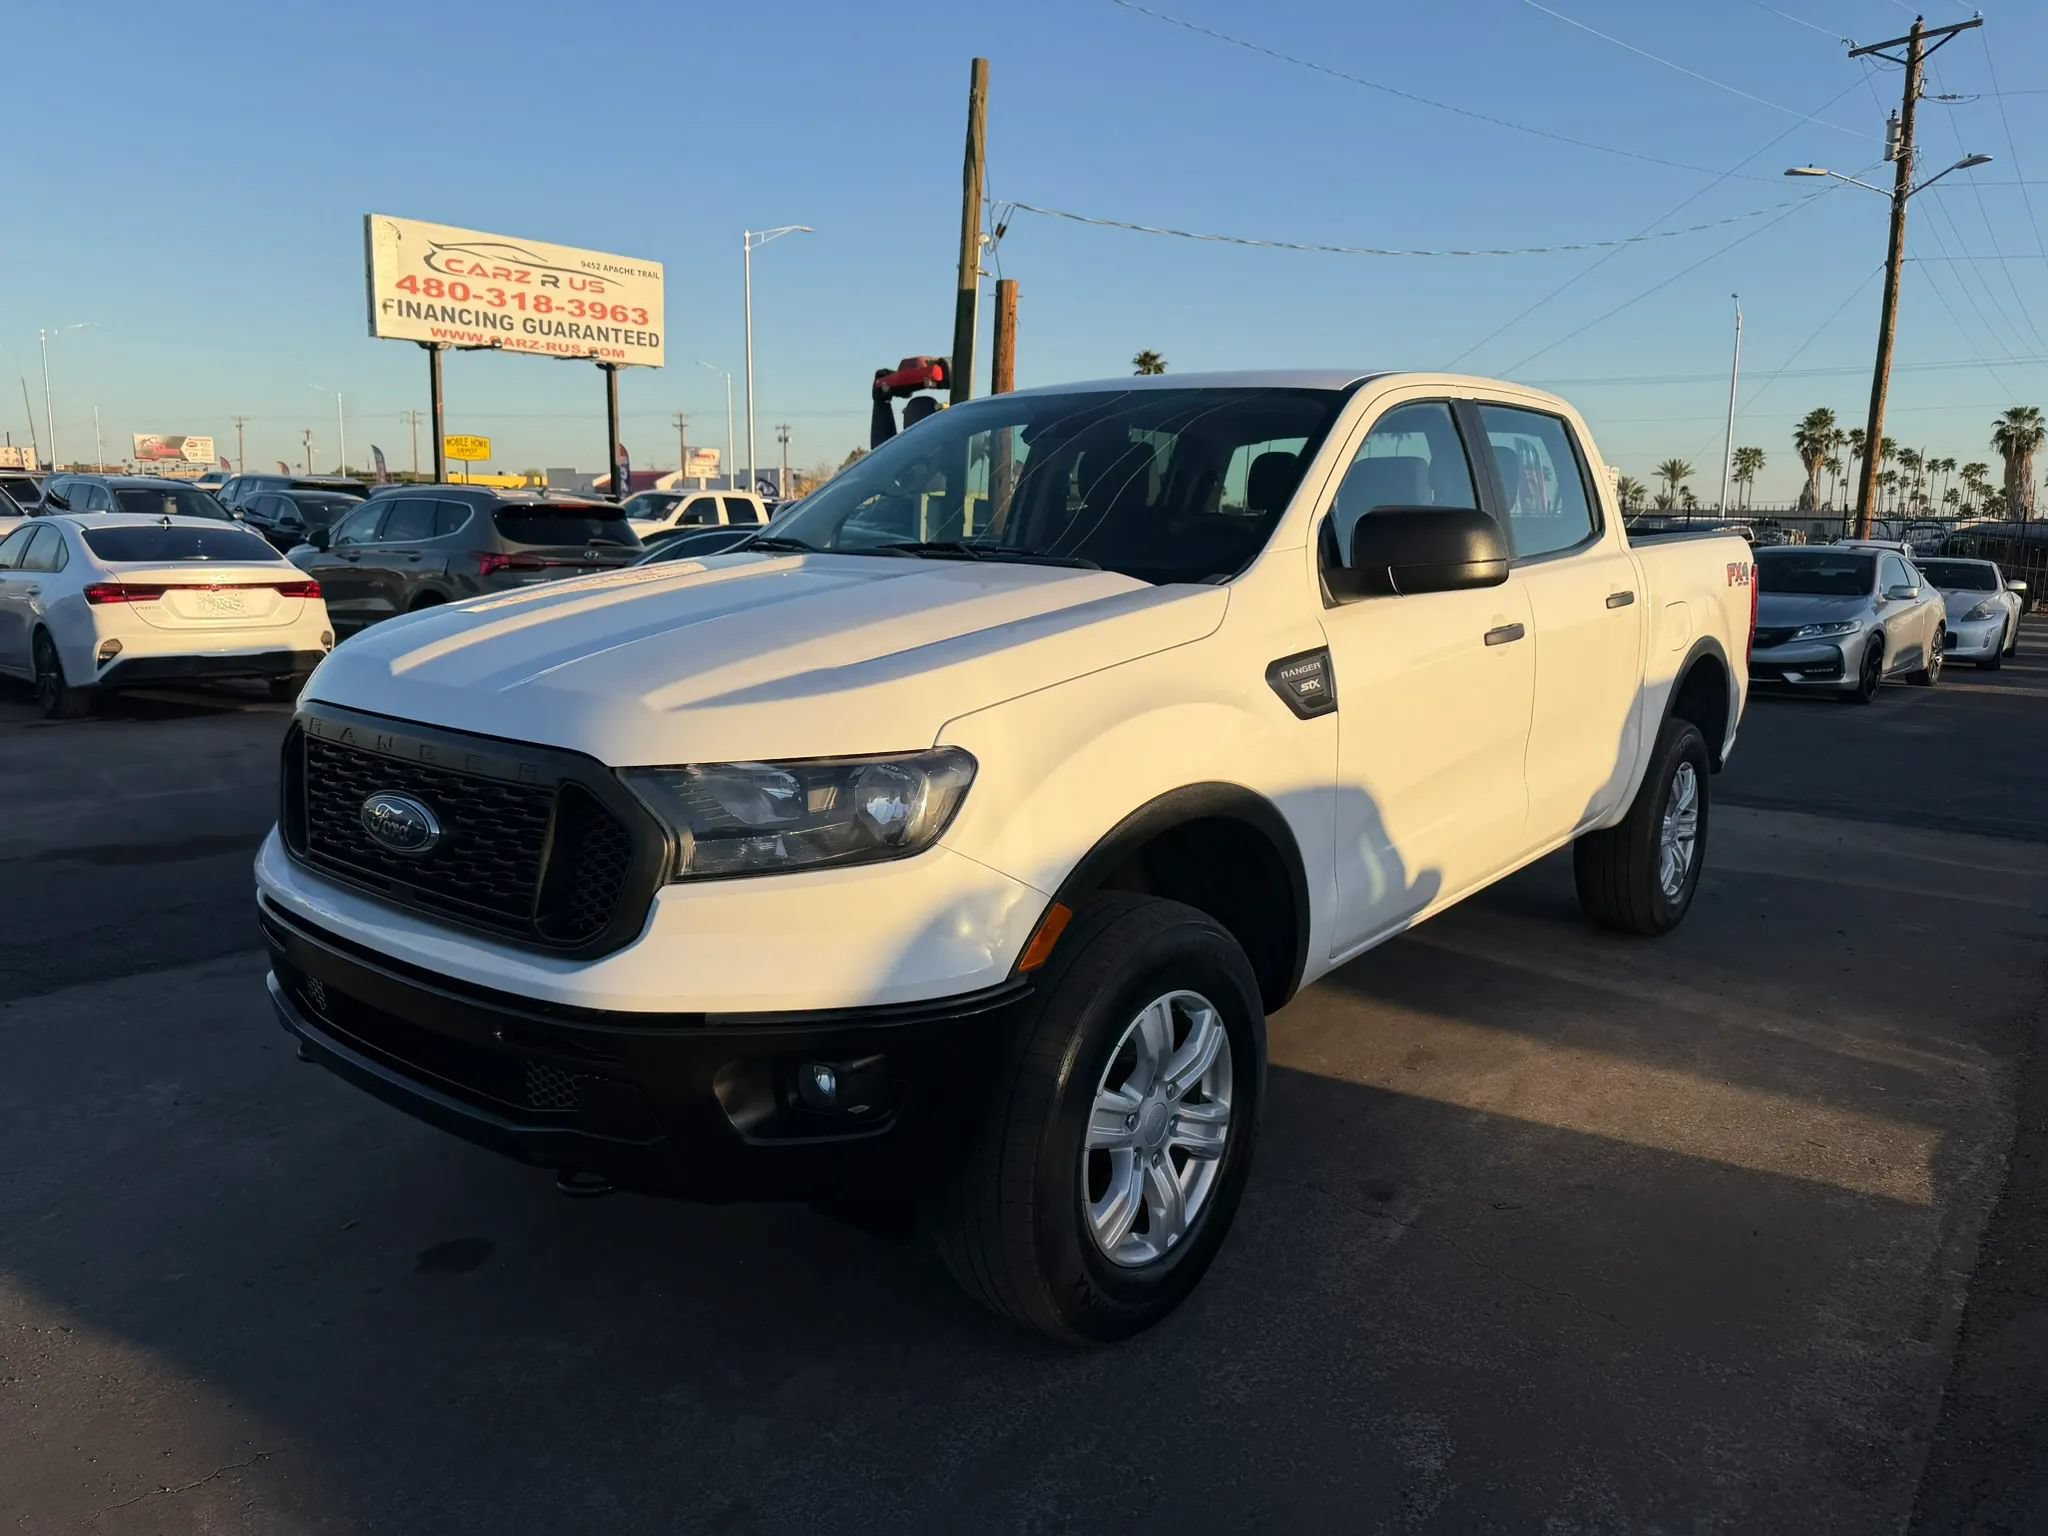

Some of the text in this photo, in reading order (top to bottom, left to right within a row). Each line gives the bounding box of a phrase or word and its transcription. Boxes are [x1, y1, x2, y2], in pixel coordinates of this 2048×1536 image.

[444, 258, 605, 294] CARZ R US
[580, 260, 660, 280] 9452 APACHE TRAIL
[395, 274, 649, 326] 480-318-3963
[382, 298, 660, 348] FINANCING GUARANTEED
[446, 437, 488, 448] MOBILE HOME
[1727, 562, 1749, 587] FX4
[1281, 661, 1321, 680] RANGER
[1300, 678, 1320, 692] STX
[370, 803, 413, 840] Ford
